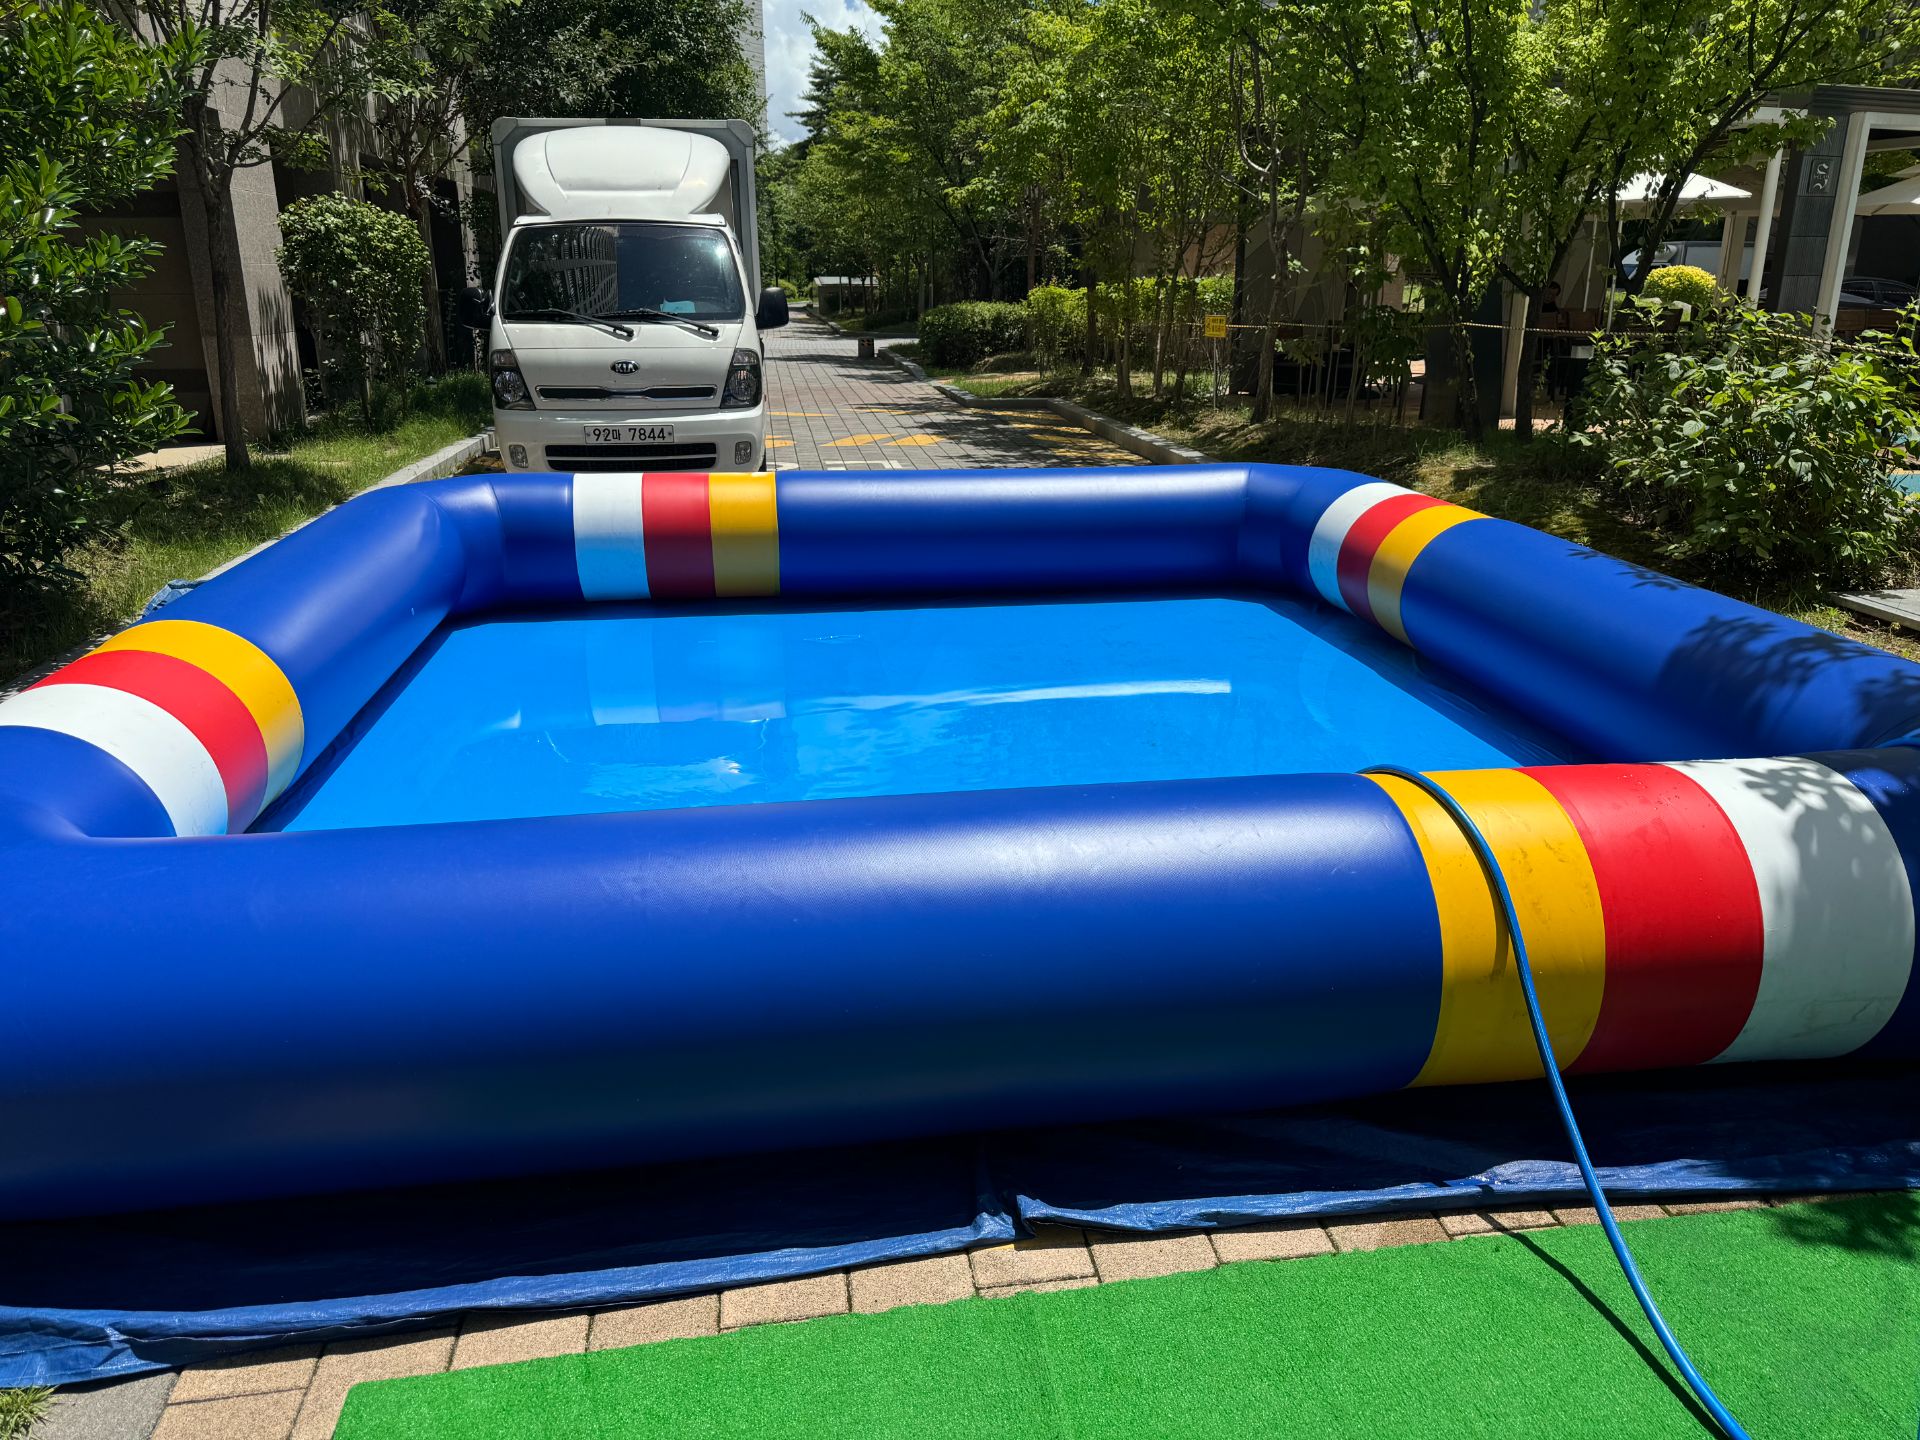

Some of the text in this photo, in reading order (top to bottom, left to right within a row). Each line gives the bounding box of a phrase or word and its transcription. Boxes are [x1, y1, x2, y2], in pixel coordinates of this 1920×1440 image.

[615, 363, 636, 373] KIA
[593, 427, 666, 442] 92마 7844
